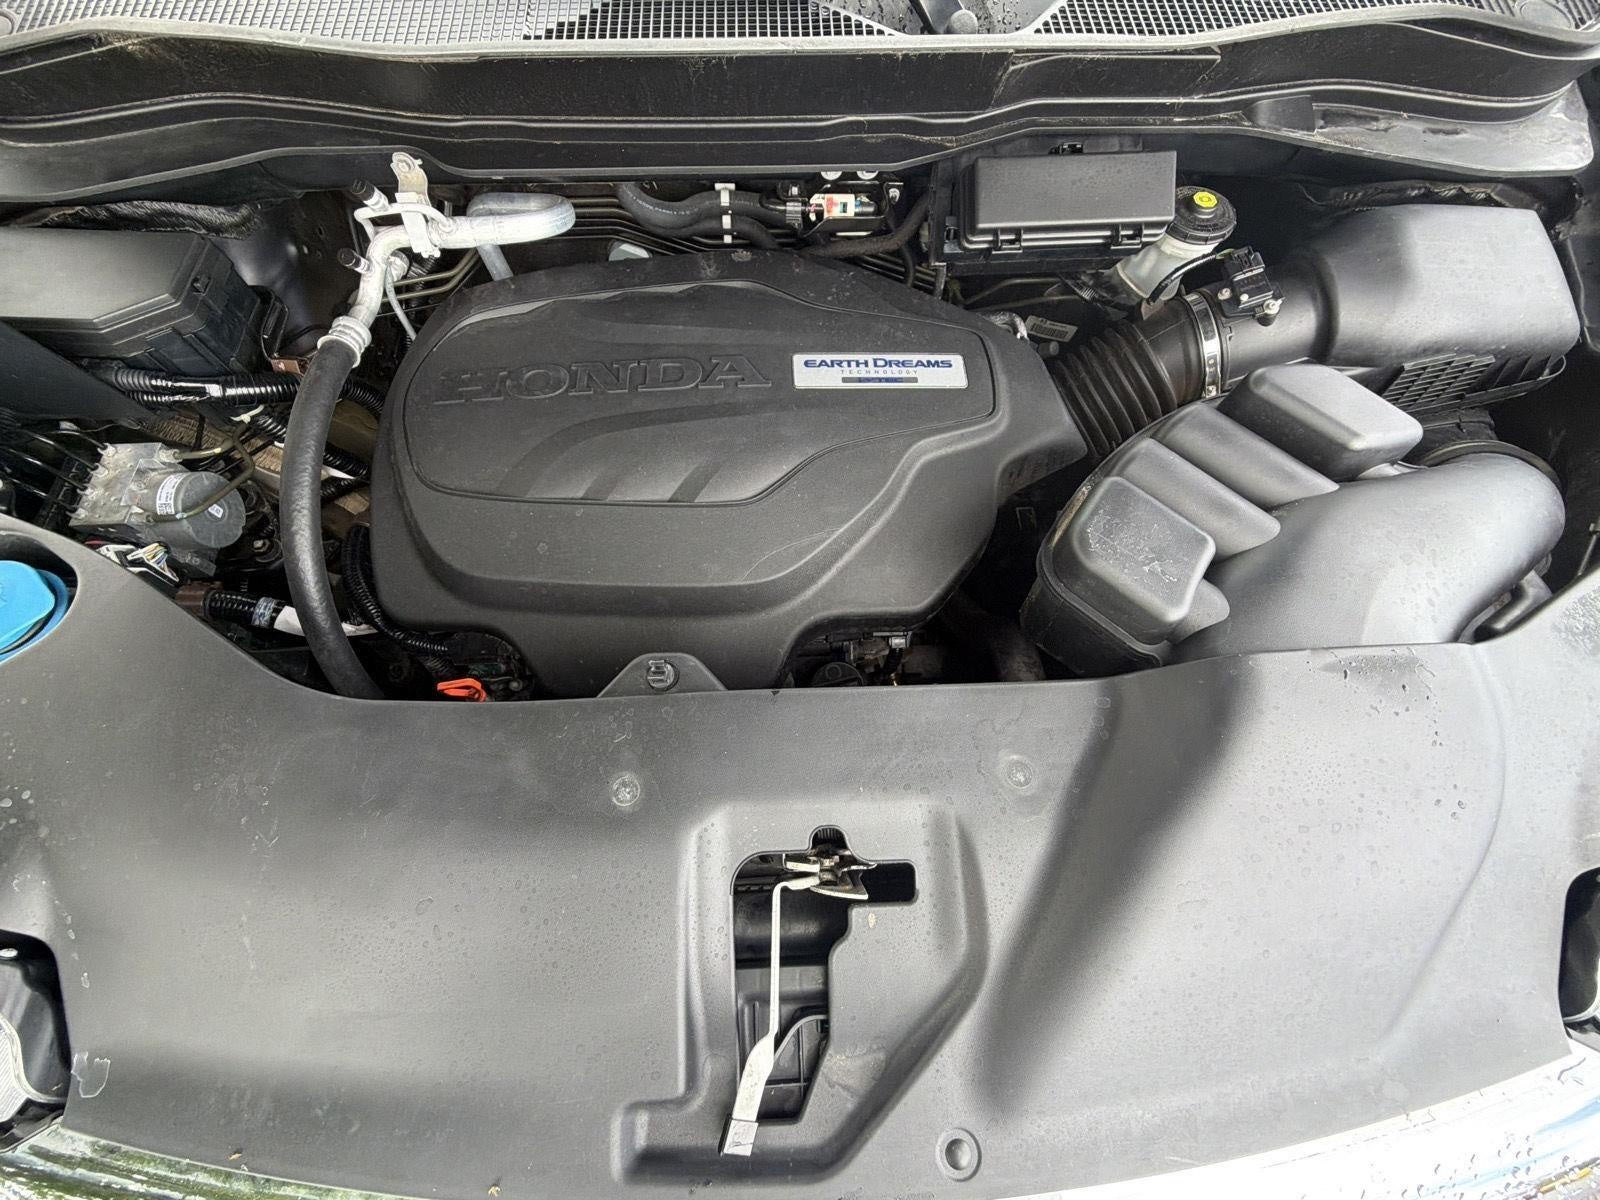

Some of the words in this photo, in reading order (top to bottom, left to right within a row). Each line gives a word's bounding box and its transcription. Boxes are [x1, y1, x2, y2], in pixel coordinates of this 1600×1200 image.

[804, 359, 868, 368] EARTH
[873, 358, 952, 368] DREAMS
[432, 354, 772, 404] HONDA
